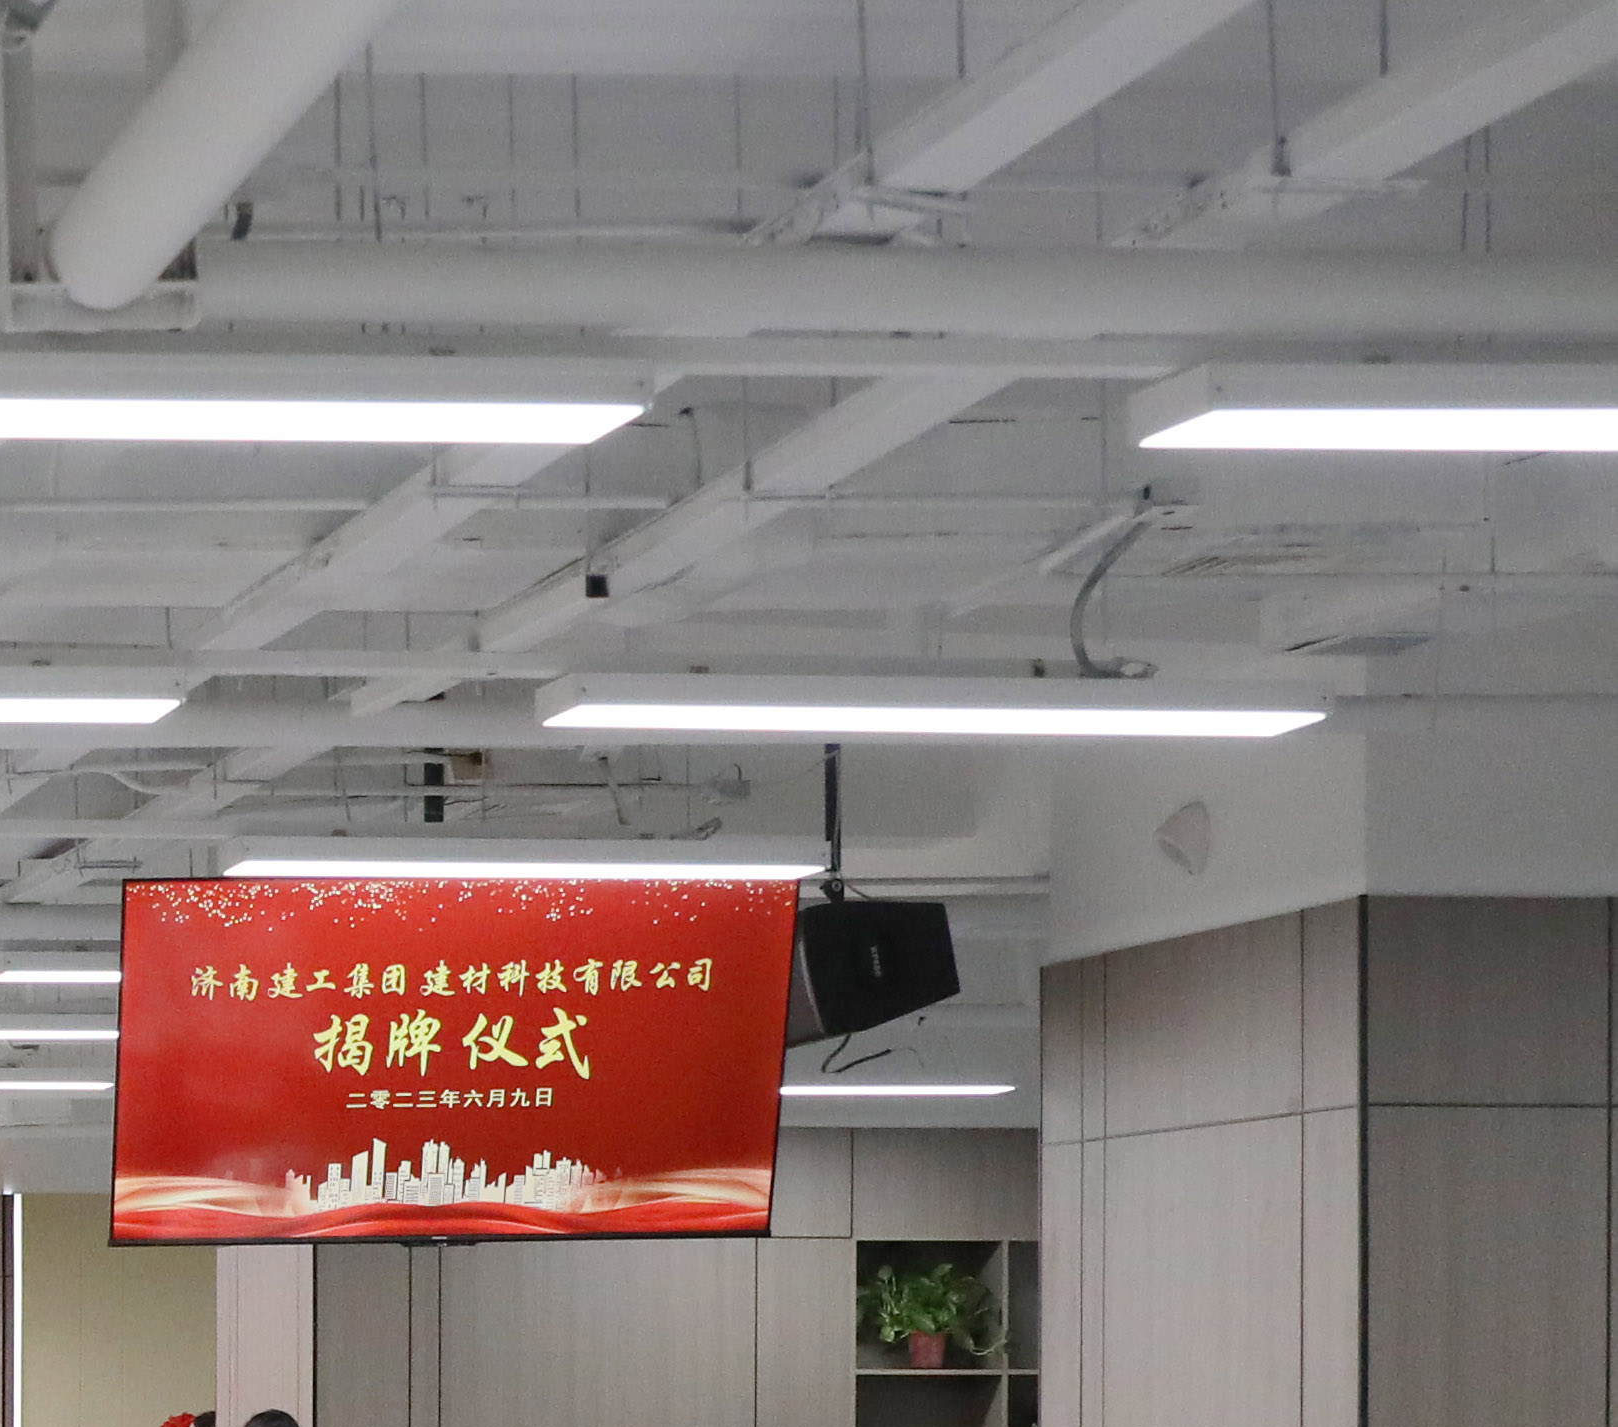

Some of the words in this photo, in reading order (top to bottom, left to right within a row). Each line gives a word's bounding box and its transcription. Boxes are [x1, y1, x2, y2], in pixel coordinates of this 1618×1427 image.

[313, 1007, 591, 1081] 揭牌仪式
[346, 1086, 553, 1110] 二零二三年六月九日
